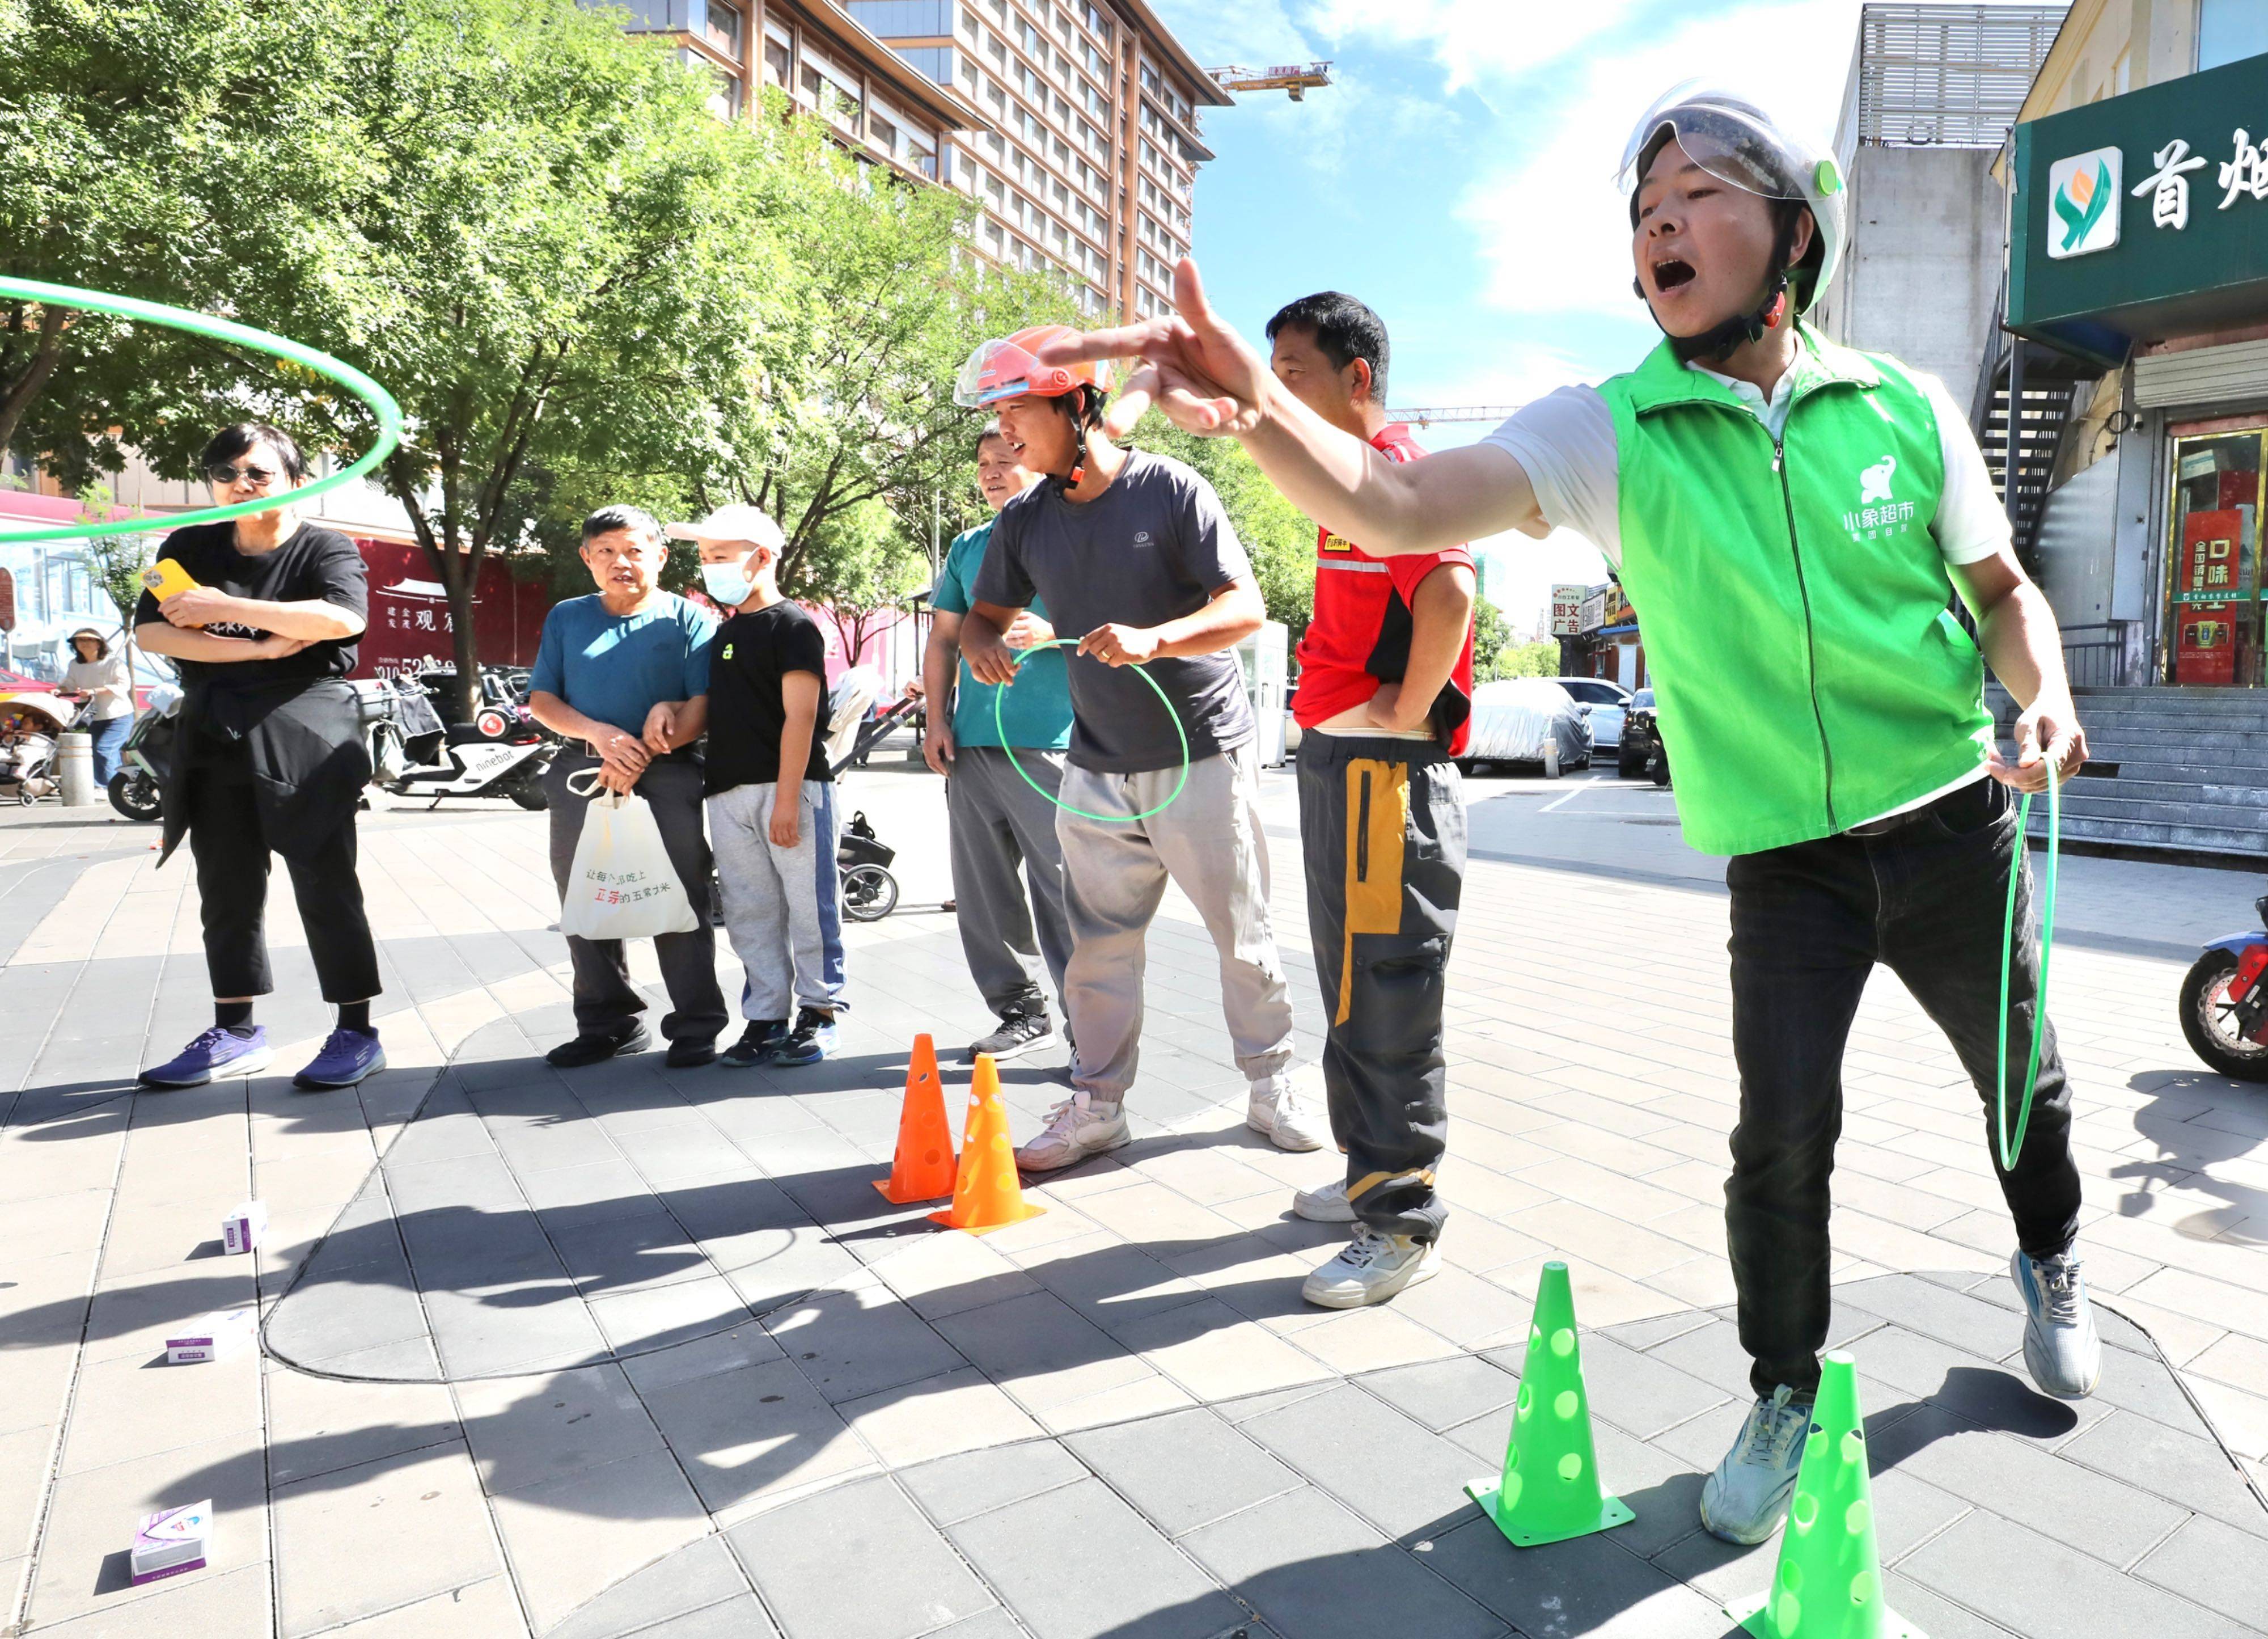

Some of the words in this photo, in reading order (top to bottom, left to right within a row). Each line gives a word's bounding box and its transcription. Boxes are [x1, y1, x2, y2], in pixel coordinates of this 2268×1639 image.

[1843, 501, 1914, 531] 小象超市
[1554, 603, 1579, 617] 图文
[1553, 619, 1579, 633] 广告
[476, 750, 515, 771] ninebot
